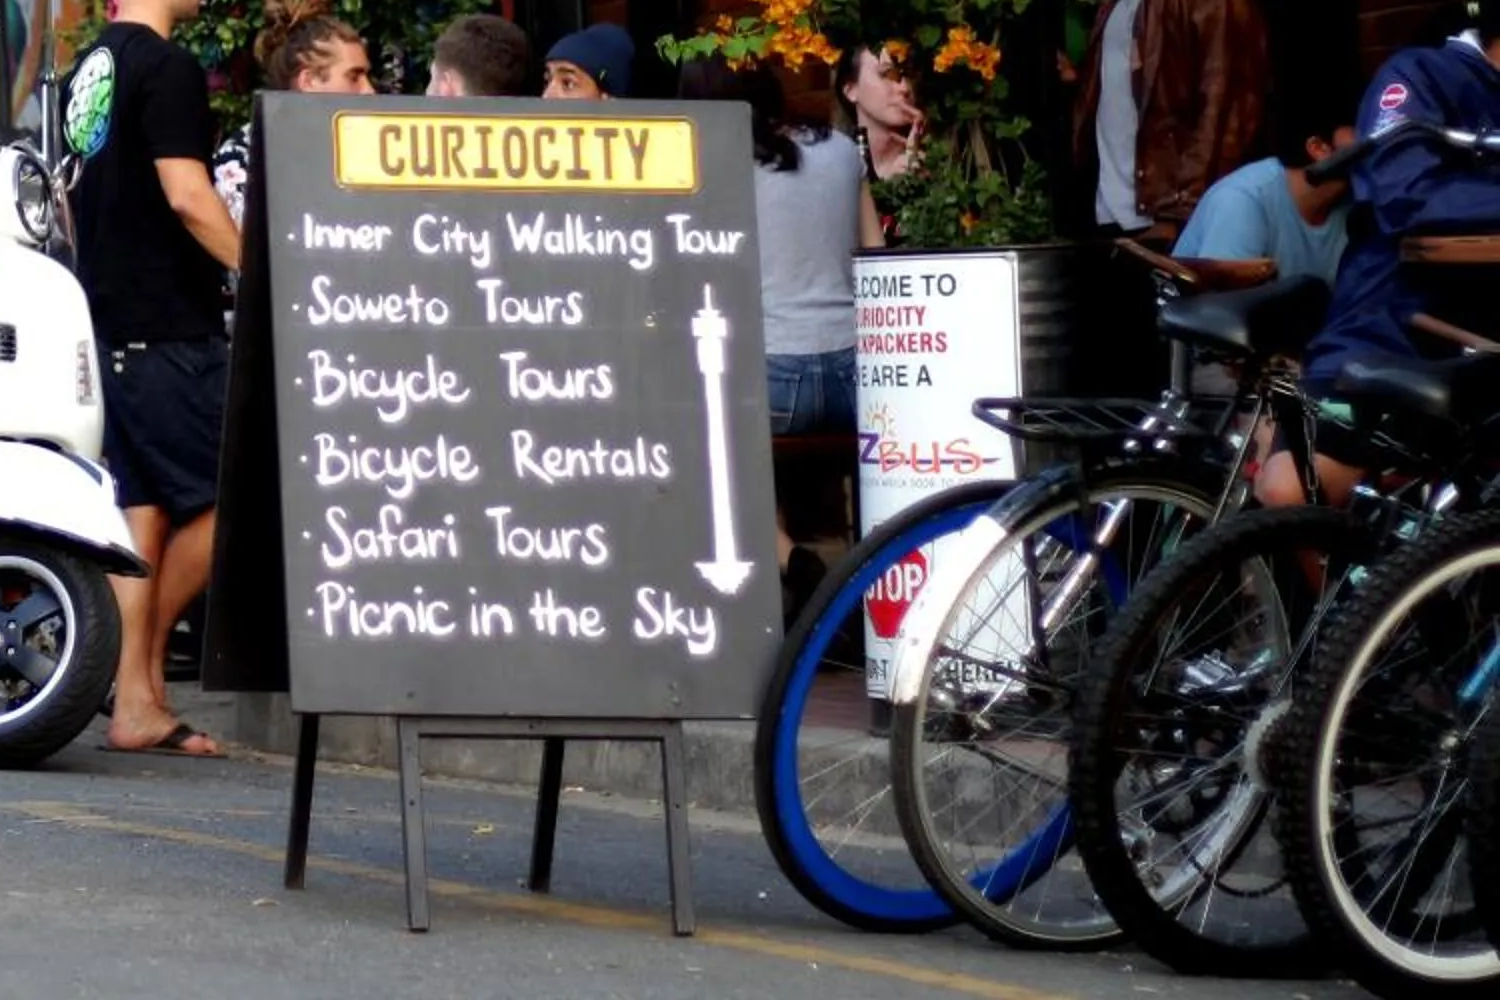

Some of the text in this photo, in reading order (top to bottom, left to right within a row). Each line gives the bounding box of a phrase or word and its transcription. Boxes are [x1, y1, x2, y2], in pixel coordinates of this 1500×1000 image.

[379, 124, 650, 180] CURIOCITY
[303, 212, 745, 270] Inner City Walking Tour
[308, 275, 584, 326] Soweto Tours
[921, 273, 957, 297] TO
[308, 350, 614, 424] Bicycle Tours
[871, 365, 909, 387] ARE
[916, 364, 932, 387] A
[314, 430, 671, 501] Bicycle Rentals
[321, 505, 610, 570] Safari Tours
[316, 581, 718, 655] Picnic in the Sky
